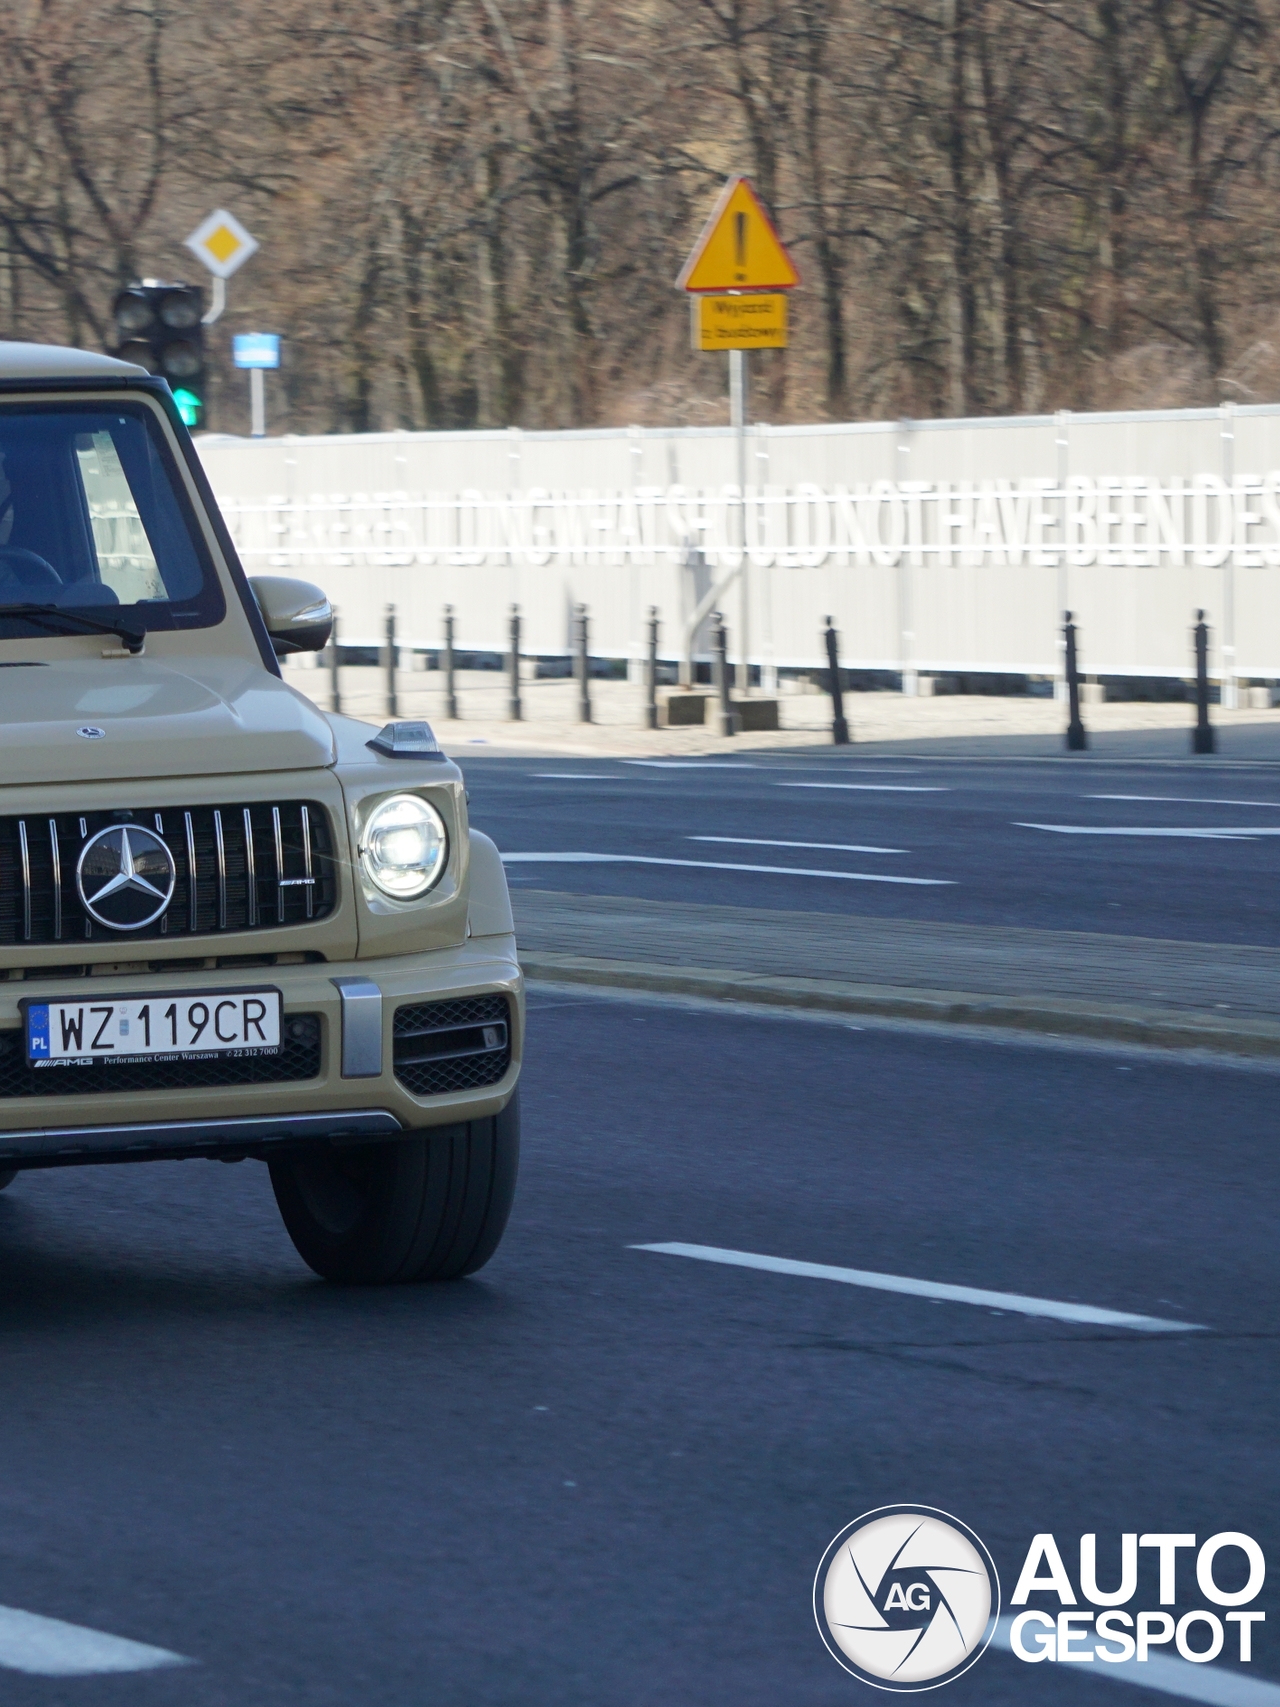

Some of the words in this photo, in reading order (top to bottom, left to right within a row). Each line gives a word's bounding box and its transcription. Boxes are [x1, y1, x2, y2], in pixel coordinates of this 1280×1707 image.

[553, 486, 661, 566] WHAT
[664, 483, 829, 567] SHOULD
[833, 480, 932, 567] NOT
[936, 477, 1060, 566] HAVE
[1066, 474, 1184, 566] BEEN
[60, 1006, 115, 1051] WZ
[137, 999, 267, 1047] 119CR
[32, 1037, 48, 1050] PL
[53, 1057, 94, 1067] AMG
[103, 1055, 153, 1065] Performance
[154, 1053, 180, 1062] Center
[181, 1051, 219, 1061] Warszawa
[233, 1049, 243, 1057] 22
[245, 1048, 258, 1056] 312
[260, 1047, 278, 1055] 7000
